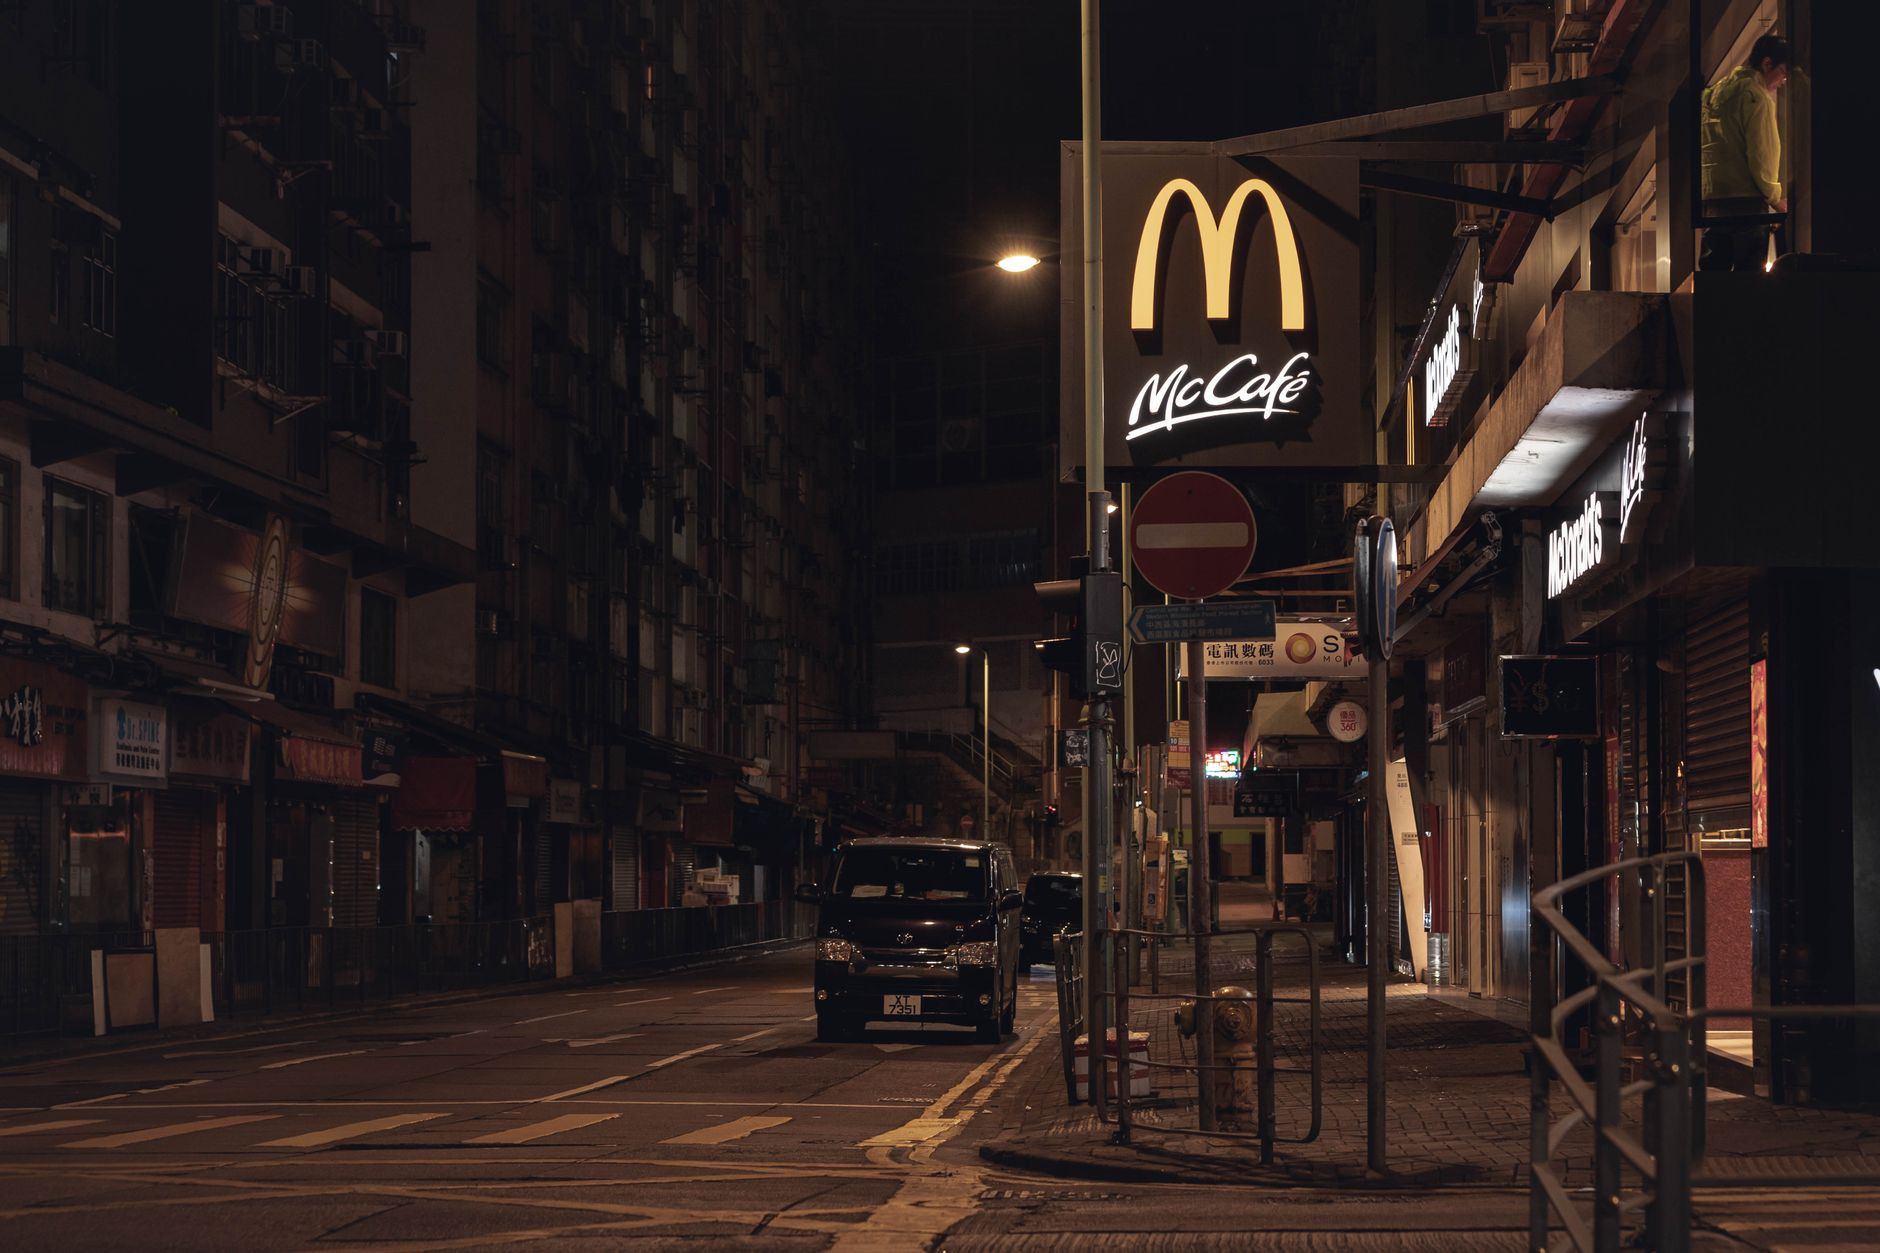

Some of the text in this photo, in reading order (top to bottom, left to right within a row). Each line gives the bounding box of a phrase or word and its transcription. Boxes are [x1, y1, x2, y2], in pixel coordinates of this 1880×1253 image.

[1127, 352, 1310, 436] McCafé
[1547, 491, 1602, 599] McDonald's
[1206, 643, 1274, 658] 電訊數碼
[895, 995, 910, 1005] XT
[888, 1004, 916, 1015] 7351
